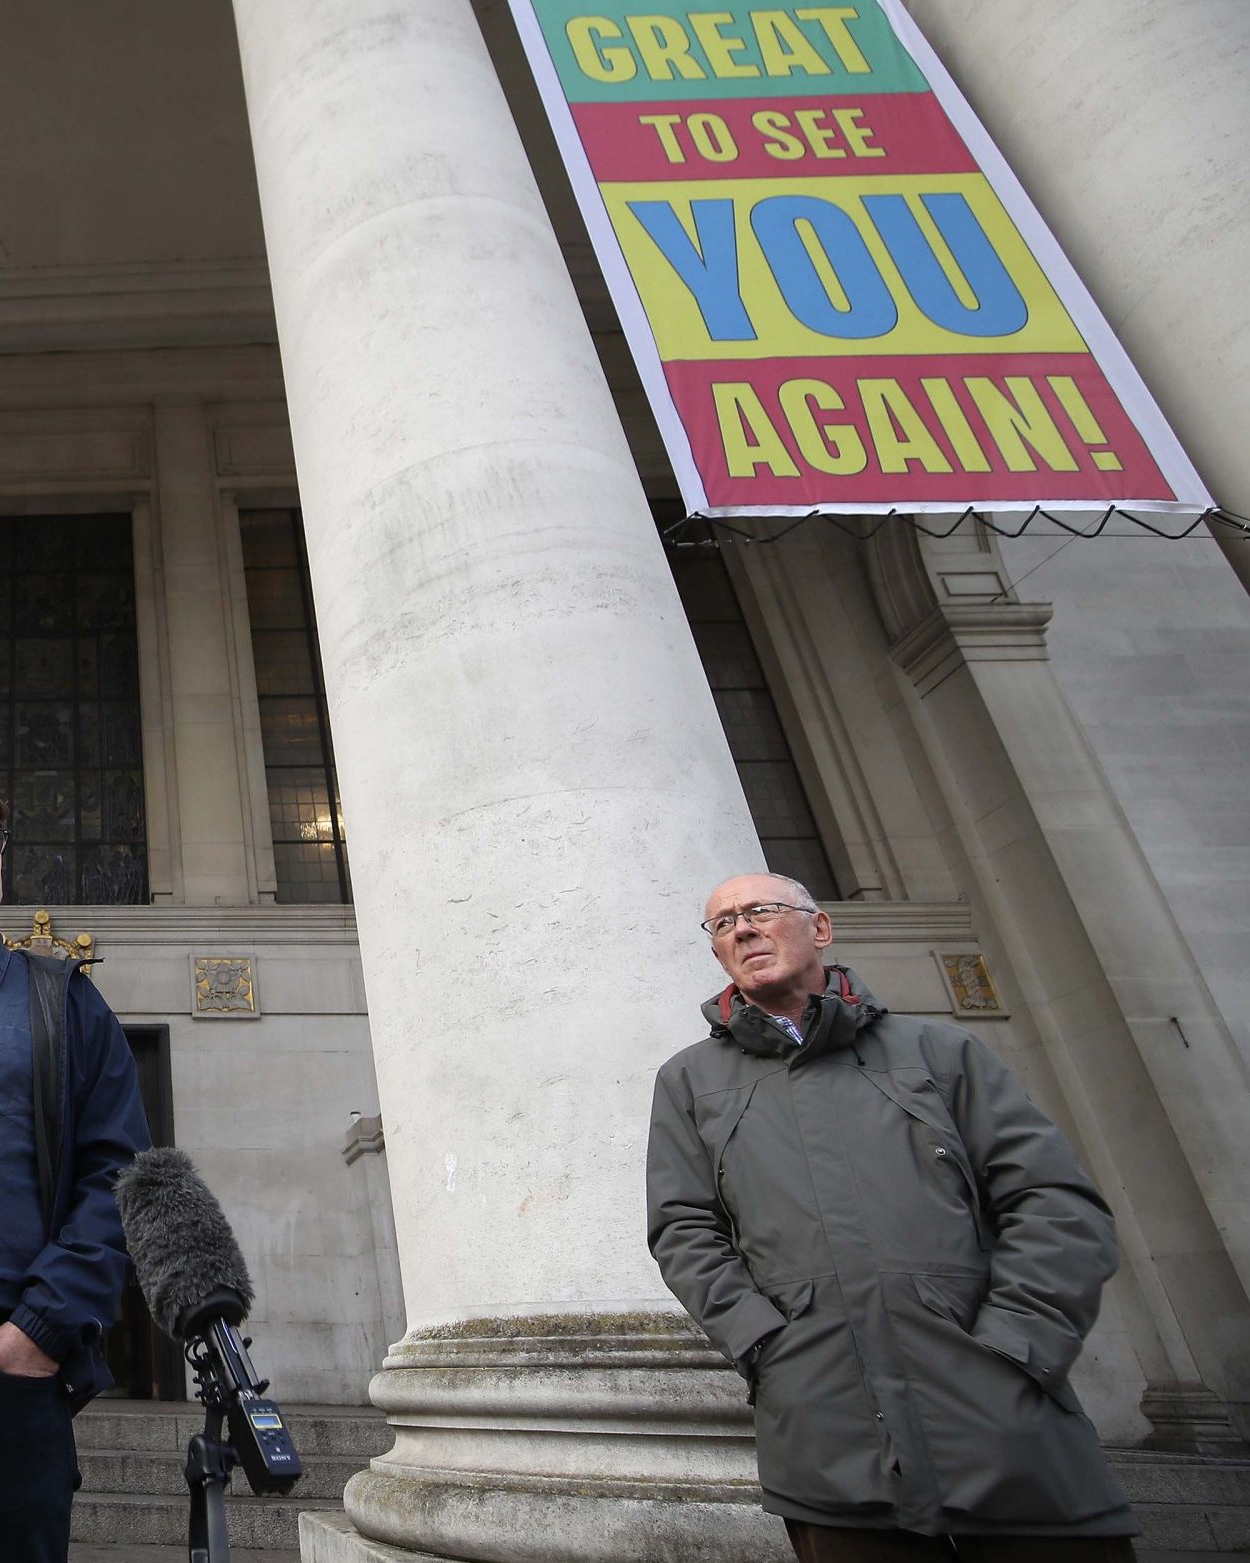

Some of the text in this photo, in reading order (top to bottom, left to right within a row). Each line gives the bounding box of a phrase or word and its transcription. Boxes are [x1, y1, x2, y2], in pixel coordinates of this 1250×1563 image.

[565, 6, 874, 84] GREAT
[638, 107, 887, 164] TO SEE
[625, 192, 1029, 342] YOU
[710, 376, 1125, 479] AGAIN!
